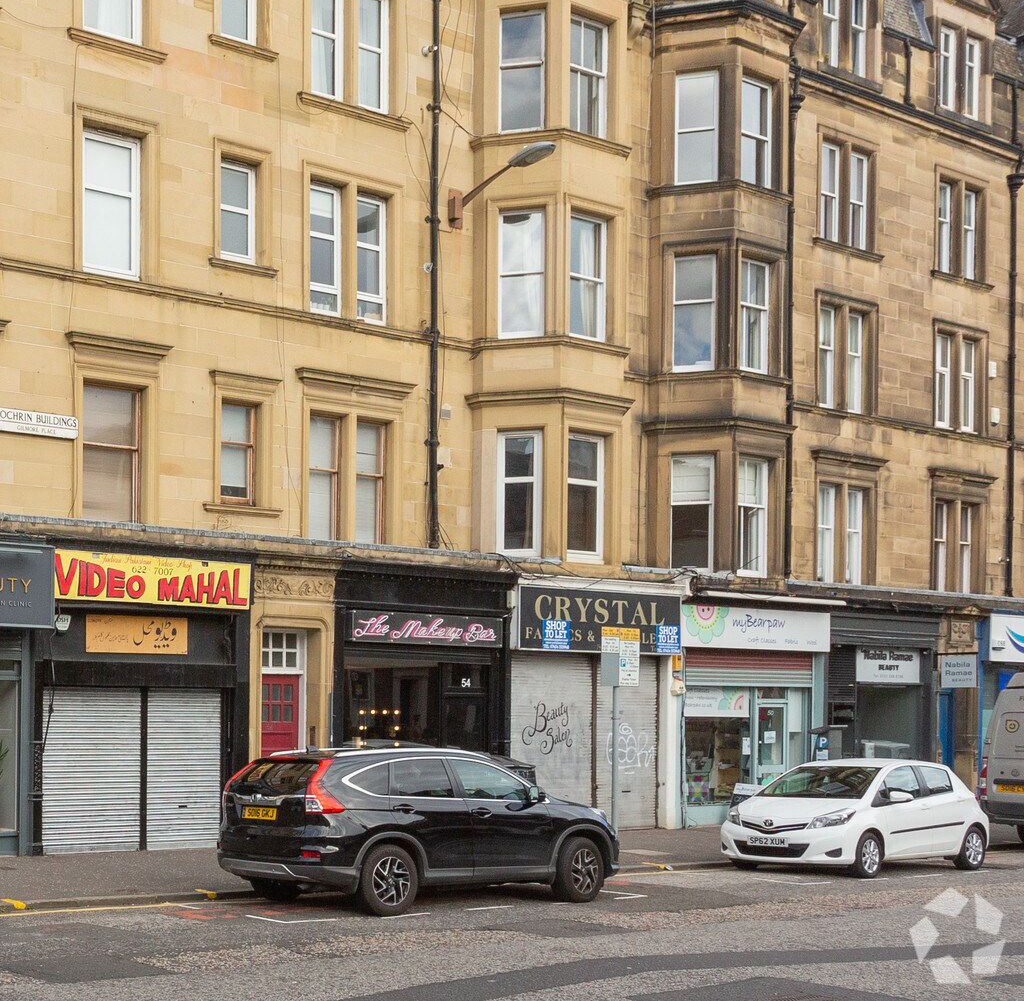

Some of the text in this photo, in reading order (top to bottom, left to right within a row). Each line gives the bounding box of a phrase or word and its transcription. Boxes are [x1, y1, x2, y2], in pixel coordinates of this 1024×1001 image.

[36, 414, 77, 428] BUILDINGS
[17, 425, 57, 435] GILMORE PLACE
[157, 557, 173, 567] Video
[176, 559, 193, 571] Shop
[131, 565, 174, 576] 622 7007
[54, 552, 248, 606] VIDEO MAHAL
[8, 600, 32, 608] CLINIC
[534, 594, 665, 626] CRYSTAL
[353, 613, 497, 643] The Makeup Bar
[546, 620, 567, 631] SHOP
[732, 613, 786, 633] myBearpaw
[545, 630, 567, 639] TO LET
[587, 631, 595, 641] &
[658, 626, 678, 635] SHOP
[658, 634, 667, 643] TO
[667, 635, 678, 643] LET
[862, 649, 914, 662] Nabila Ramae
[461, 678, 471, 688] 54
[522, 701, 569, 746] Beauty
[819, 736, 828, 748] P
[749, 836, 768, 845] SP62
